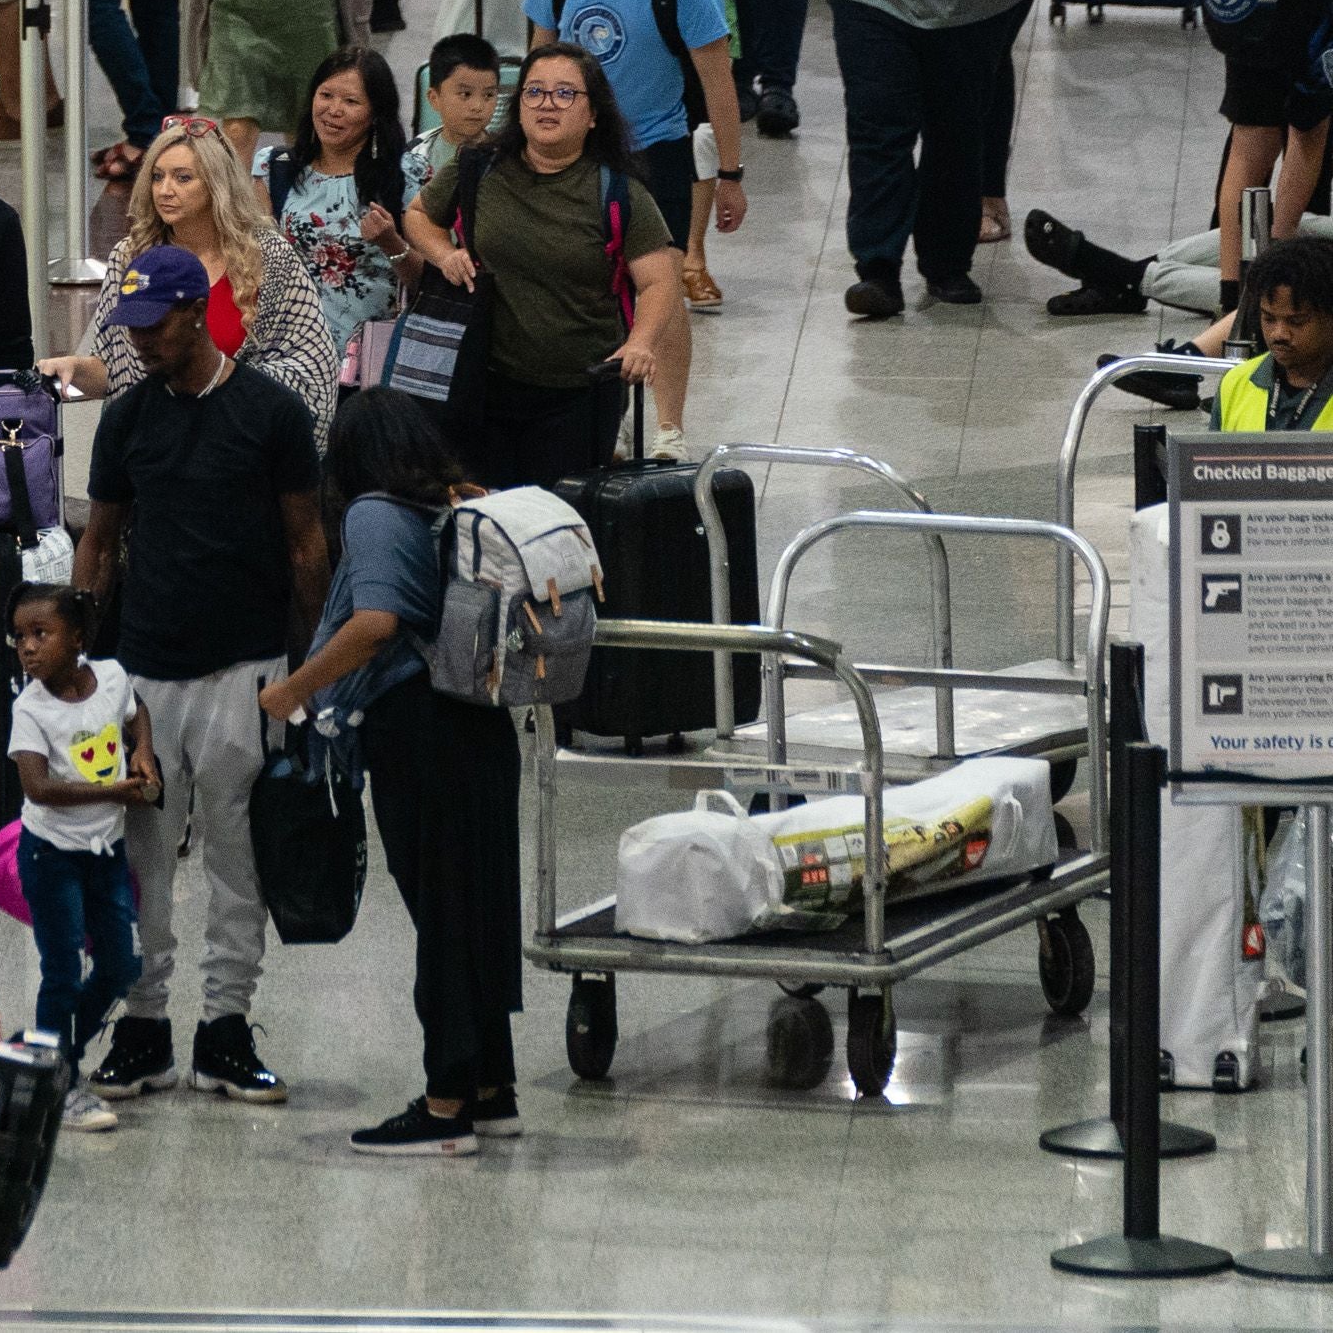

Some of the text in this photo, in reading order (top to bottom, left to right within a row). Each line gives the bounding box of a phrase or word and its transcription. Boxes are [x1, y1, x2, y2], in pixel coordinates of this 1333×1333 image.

[1193, 465, 1263, 481] Checked
[1247, 513, 1310, 523] Are your bags
[1248, 673, 1324, 683] Are you carrying
[1211, 733, 1323, 751] Your safety is
